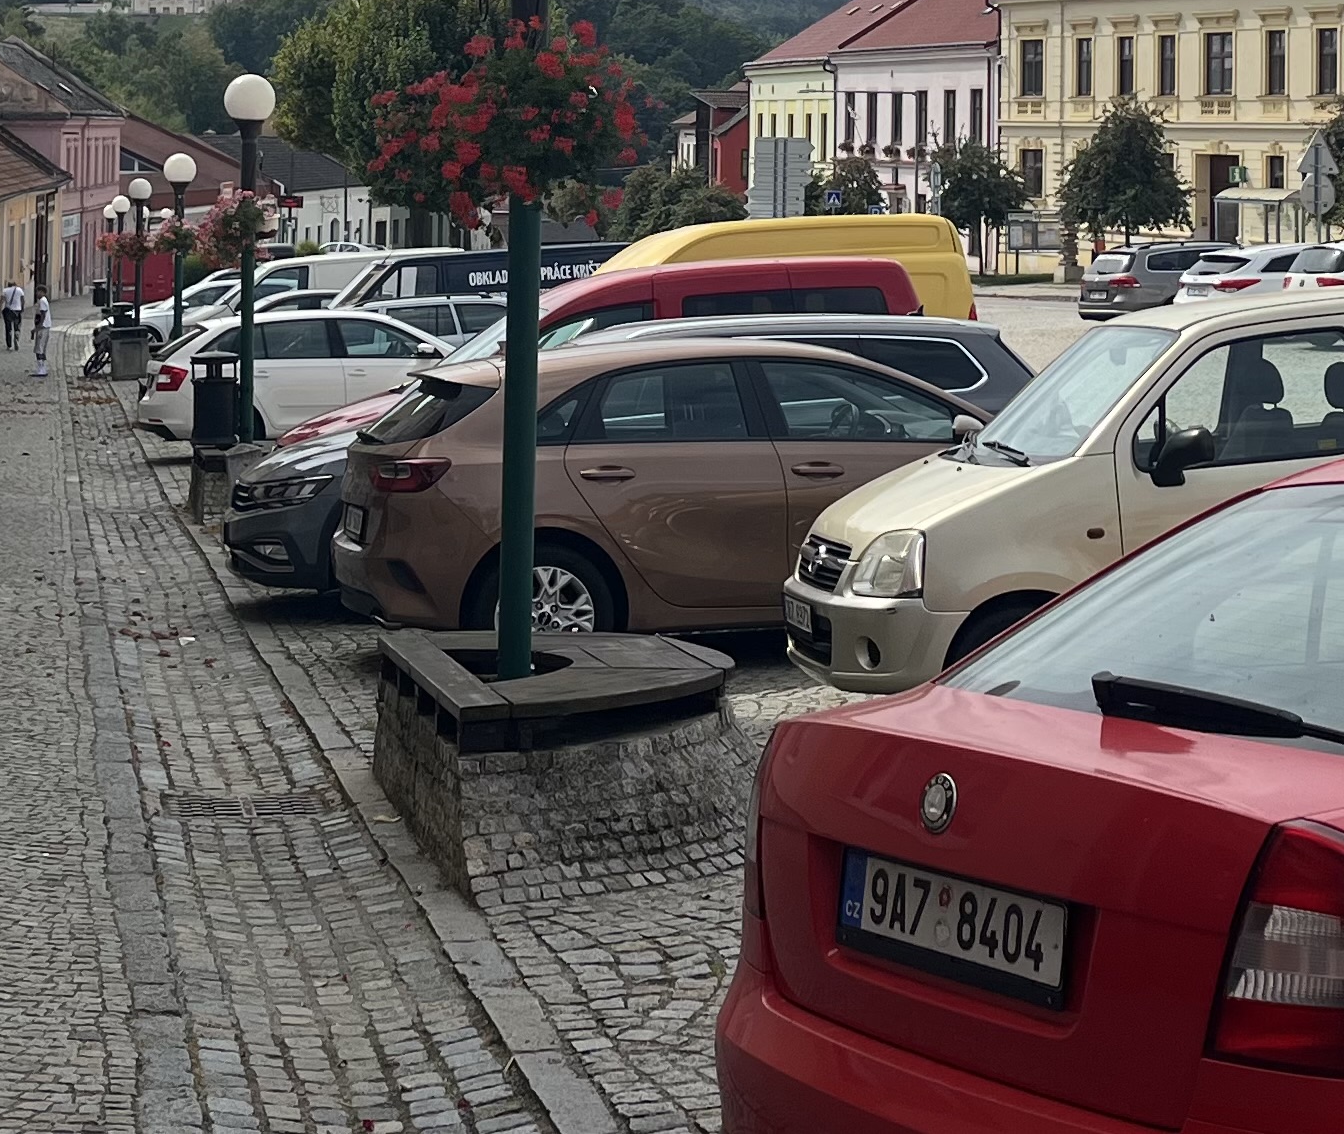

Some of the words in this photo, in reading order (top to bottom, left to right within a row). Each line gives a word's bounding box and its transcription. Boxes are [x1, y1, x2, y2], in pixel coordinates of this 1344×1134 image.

[540, 262, 572, 281] PRÁCE
[845, 899, 862, 919] CZ
[870, 868, 932, 936] 9A7
[957, 891, 1045, 972] 8404
